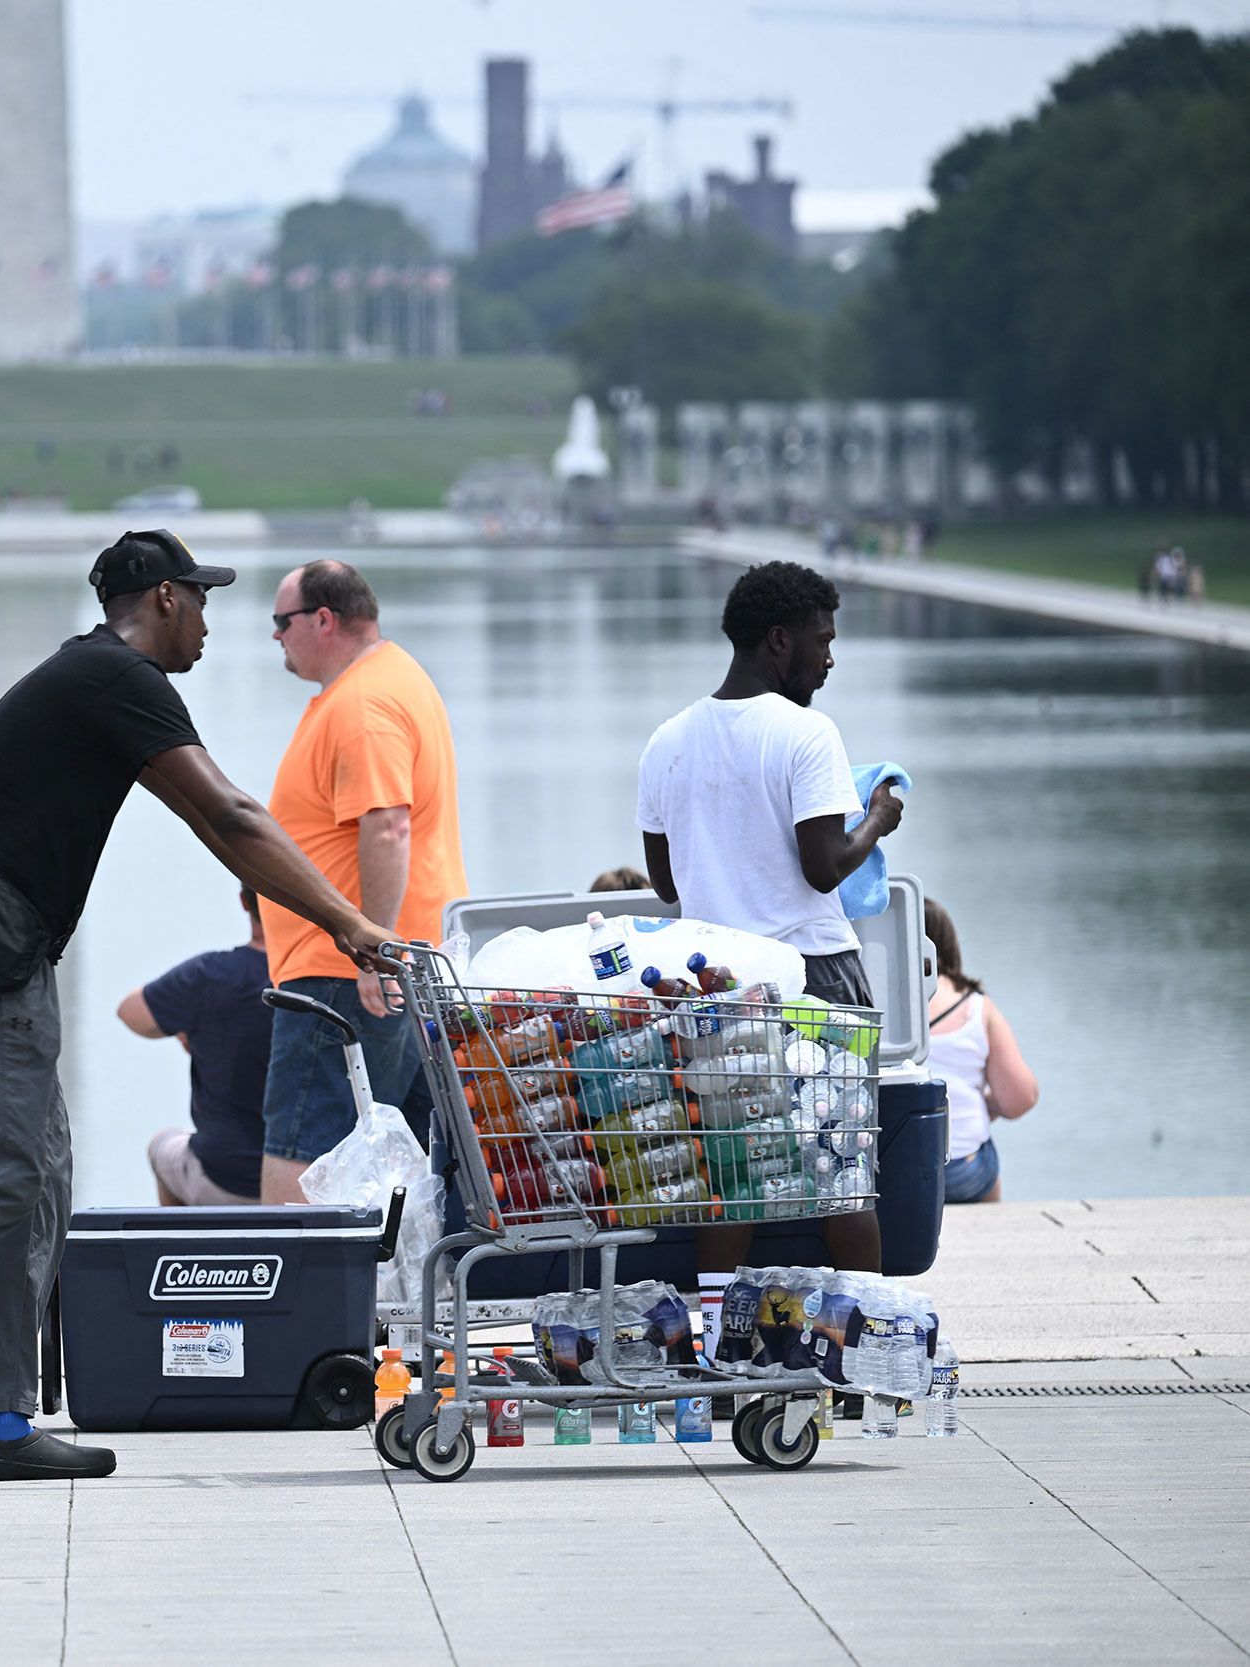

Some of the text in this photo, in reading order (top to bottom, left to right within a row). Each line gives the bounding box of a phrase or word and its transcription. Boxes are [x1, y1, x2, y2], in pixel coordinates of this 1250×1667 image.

[165, 1262, 249, 1287] Coleman
[172, 1326, 202, 1336] Coleman
[502, 1399, 519, 1418] G
